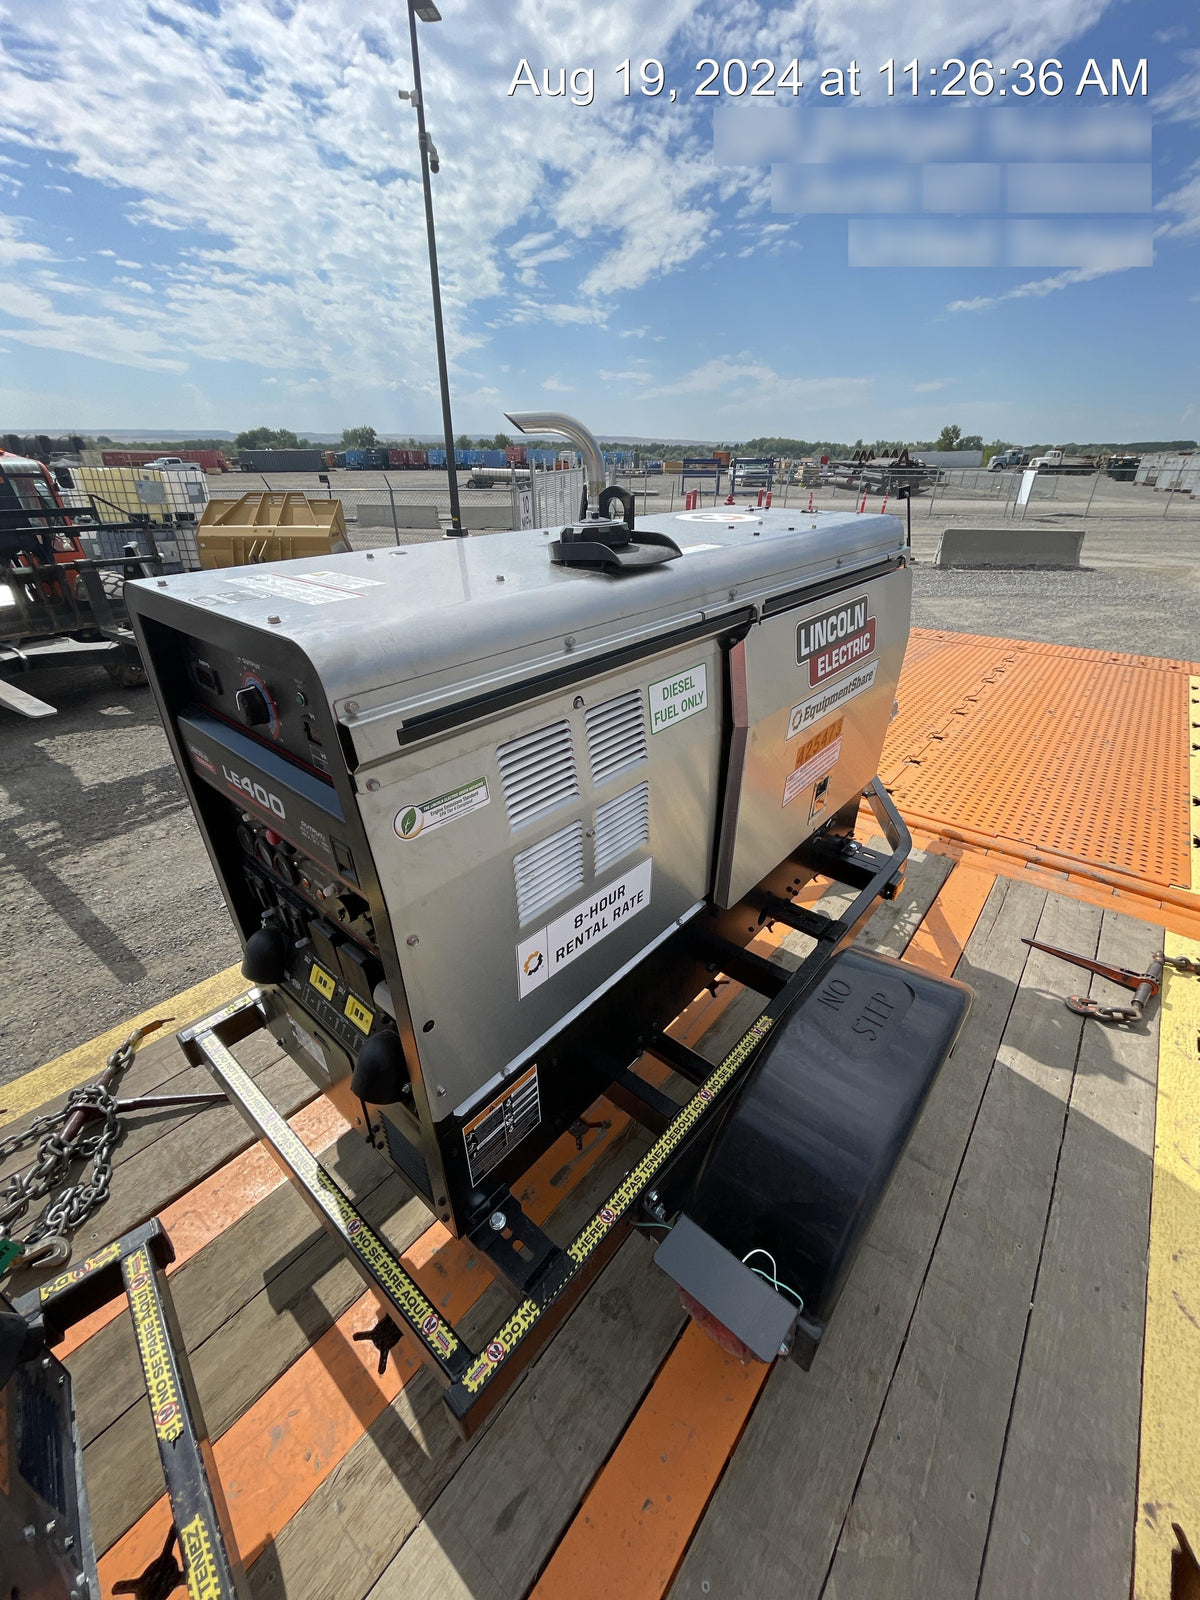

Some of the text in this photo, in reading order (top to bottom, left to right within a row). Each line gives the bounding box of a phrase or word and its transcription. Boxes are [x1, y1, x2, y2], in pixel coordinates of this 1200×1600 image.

[800, 602, 865, 657] LINCOLN
[817, 632, 871, 677] ELECTRIC
[654, 690, 704, 726] FUEL ONLY
[662, 675, 695, 701] DIESEL
[803, 670, 874, 722] EquipmentShare
[221, 764, 286, 820] LE400
[555, 890, 644, 963] RENTAL RATE
[574, 884, 626, 929] 8-HOUR
[817, 979, 851, 1012] NO
[235, 1076, 255, 1098] STAND
[708, 1079, 721, 1093] NO
[719, 1068, 729, 1080] SE
[727, 1051, 743, 1070] PARE
[611, 1100, 704, 1211] NE PAS TENEZ DEBOUT ICI
[339, 1207, 351, 1222] ICI
[576, 1222, 605, 1253] HERE
[356, 1231, 371, 1249] NO
[369, 1243, 383, 1263] SE
[380, 1260, 405, 1291] PARE
[143, 1322, 160, 1359] PARE
[502, 1301, 540, 1345] DO NO
[151, 1357, 165, 1379] SE
[155, 1379, 169, 1405] NO
[186, 1524, 211, 1599] TENEZ
